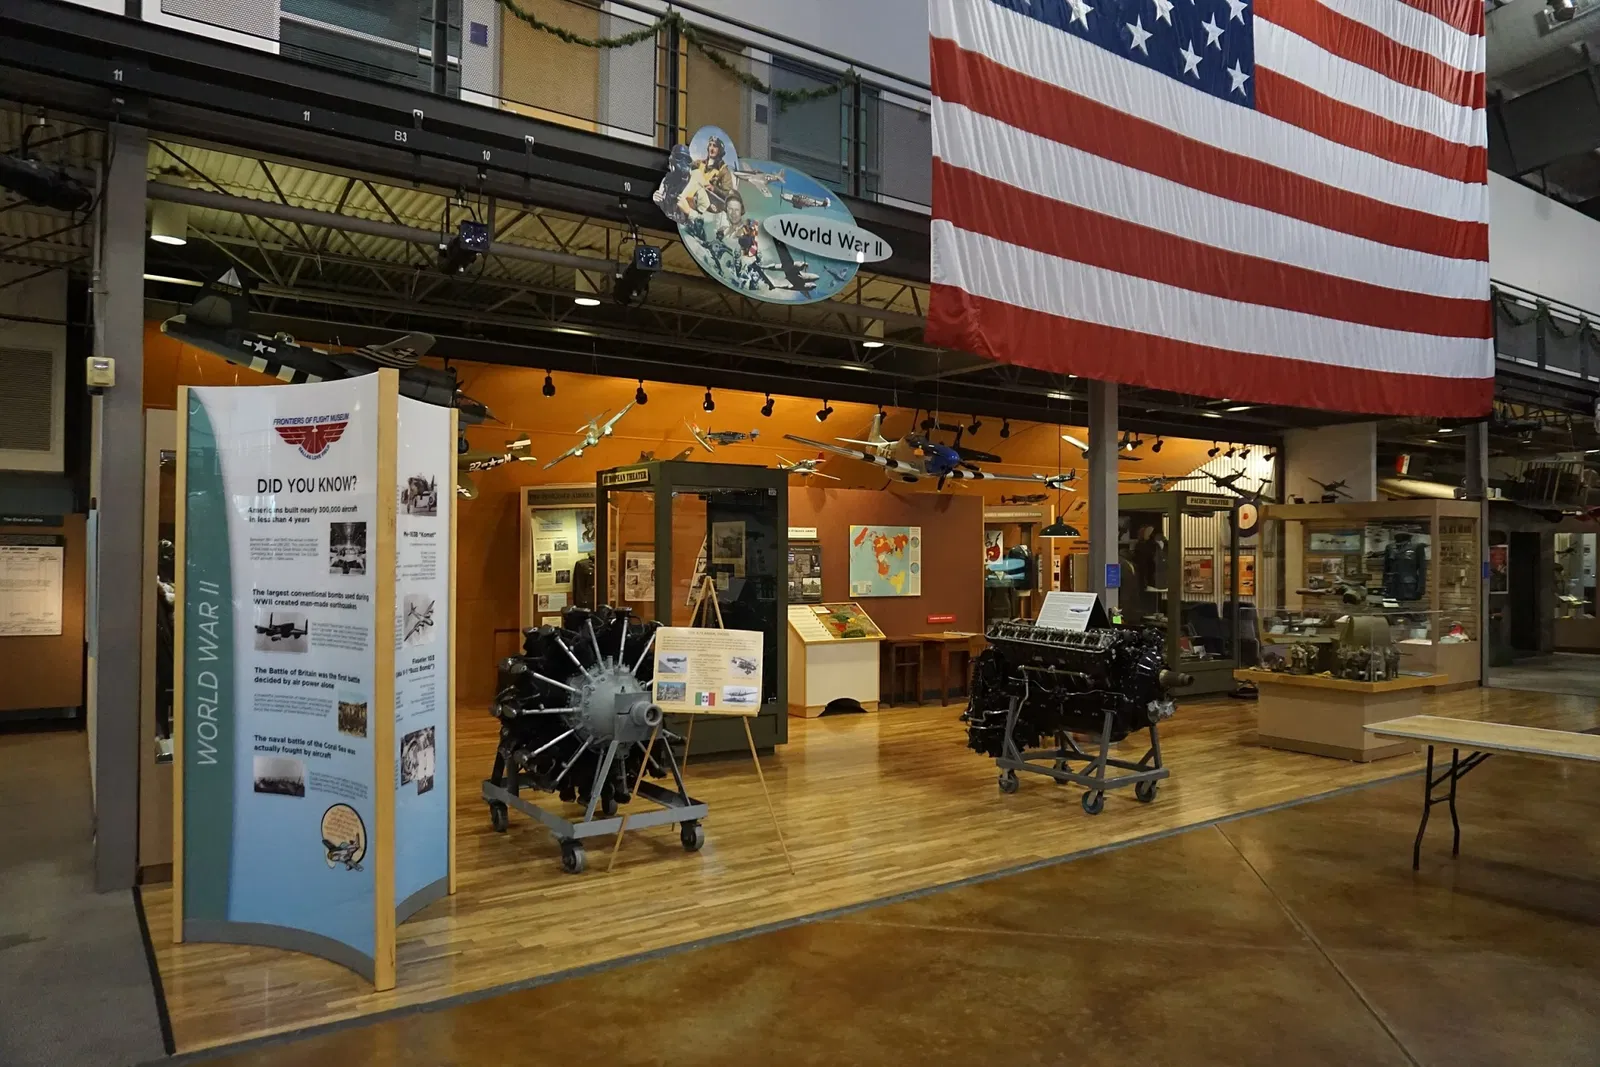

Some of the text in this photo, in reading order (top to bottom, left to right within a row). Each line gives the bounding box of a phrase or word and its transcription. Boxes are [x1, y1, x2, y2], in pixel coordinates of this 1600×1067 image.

[113, 69, 123, 81] 11
[303, 111, 311, 121] 11
[394, 130, 407, 142] B3
[482, 150, 491, 161] 10
[624, 182, 631, 192] 10
[780, 219, 883, 257] World War II
[273, 413, 350, 426] FRONTIERS OF FLIGHT MUSEUM
[257, 475, 358, 494] DID YOU KNOW?
[284, 506, 299, 514] built
[300, 506, 317, 515] nearly
[319, 506, 340, 514] 300,000
[342, 505, 358, 513] aircraft
[266, 589, 289, 597] largest
[290, 590, 327, 598] conventional
[328, 591, 344, 599] bombs
[356, 593, 370, 602] during
[329, 602, 357, 610] earthquakes
[197, 580, 220, 765] WORLD WAR II
[269, 667, 289, 675] Battle
[329, 672, 337, 680] the
[337, 673, 347, 681] first
[347, 676, 360, 684] battle
[254, 676, 281, 684] decided
[283, 678, 291, 686] by
[254, 734, 267, 742] The
[287, 737, 306, 745] battle
[314, 740, 323, 748] the
[324, 742, 337, 751] Coral
[338, 745, 347, 753] Sea
[254, 744, 332, 760] actually fought by aircraft
